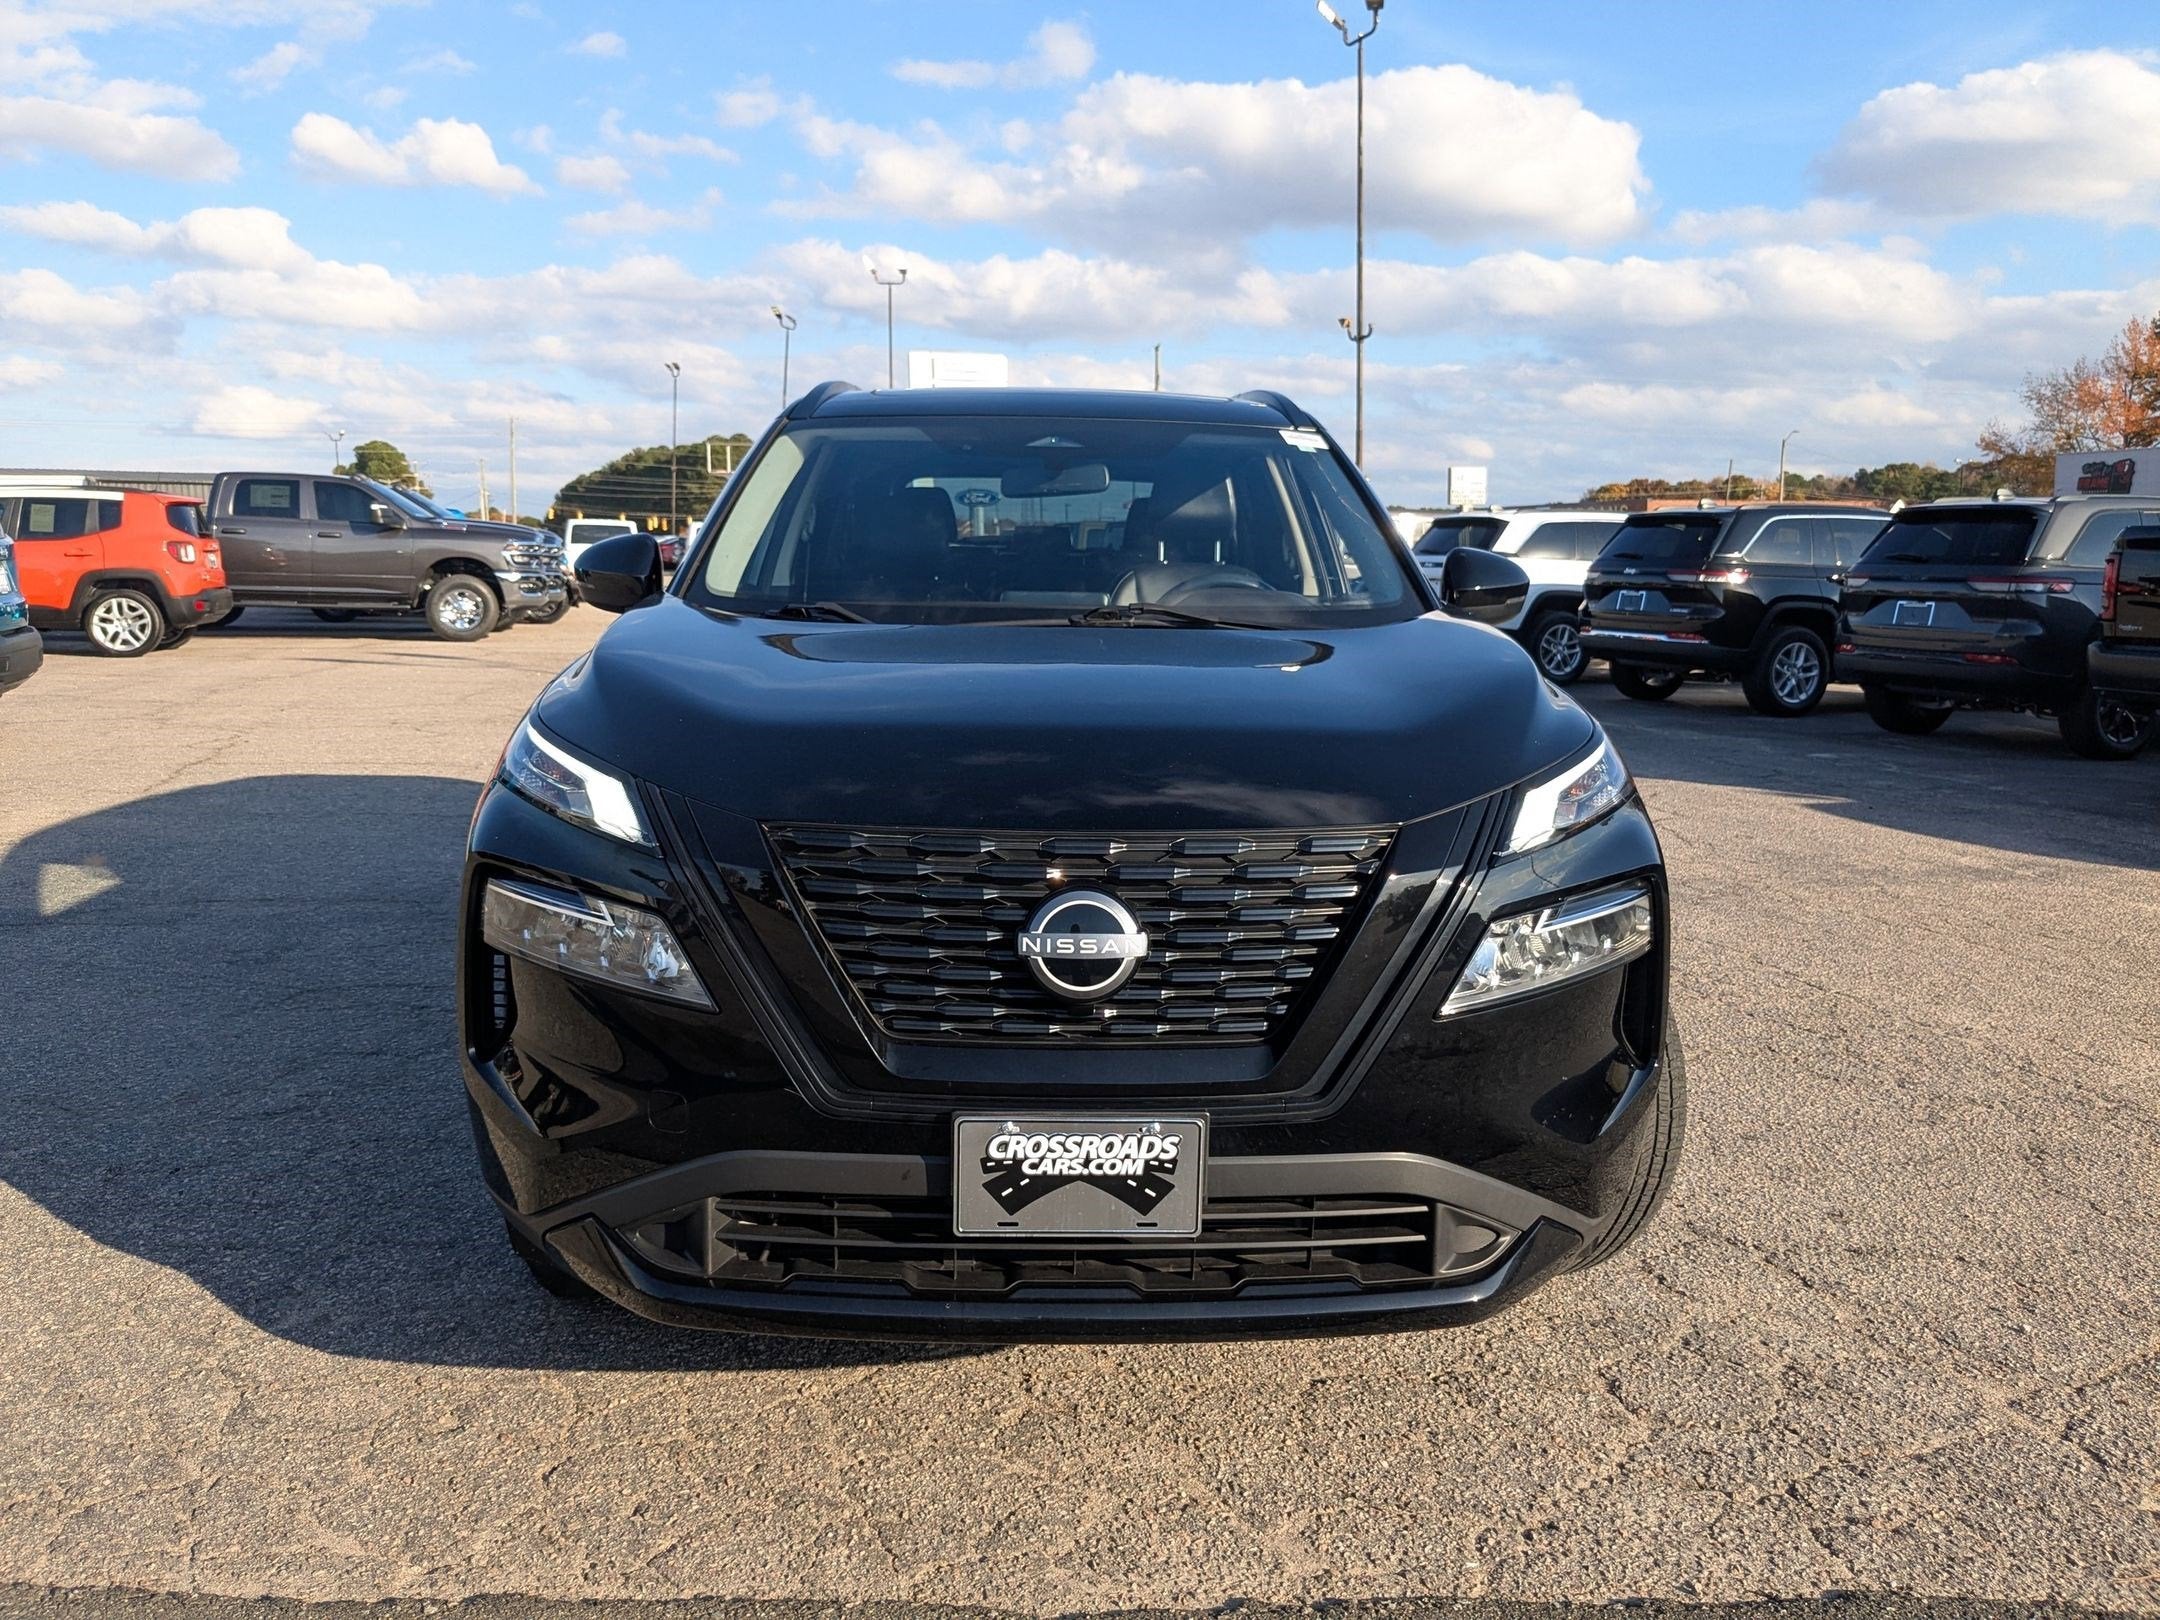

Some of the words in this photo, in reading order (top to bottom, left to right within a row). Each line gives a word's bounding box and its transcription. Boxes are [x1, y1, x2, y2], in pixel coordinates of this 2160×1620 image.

[1022, 937, 1143, 954] NISSAN
[986, 1135, 1179, 1160] CROSSROADS
[1021, 1158, 1145, 1176] CARS.COM
